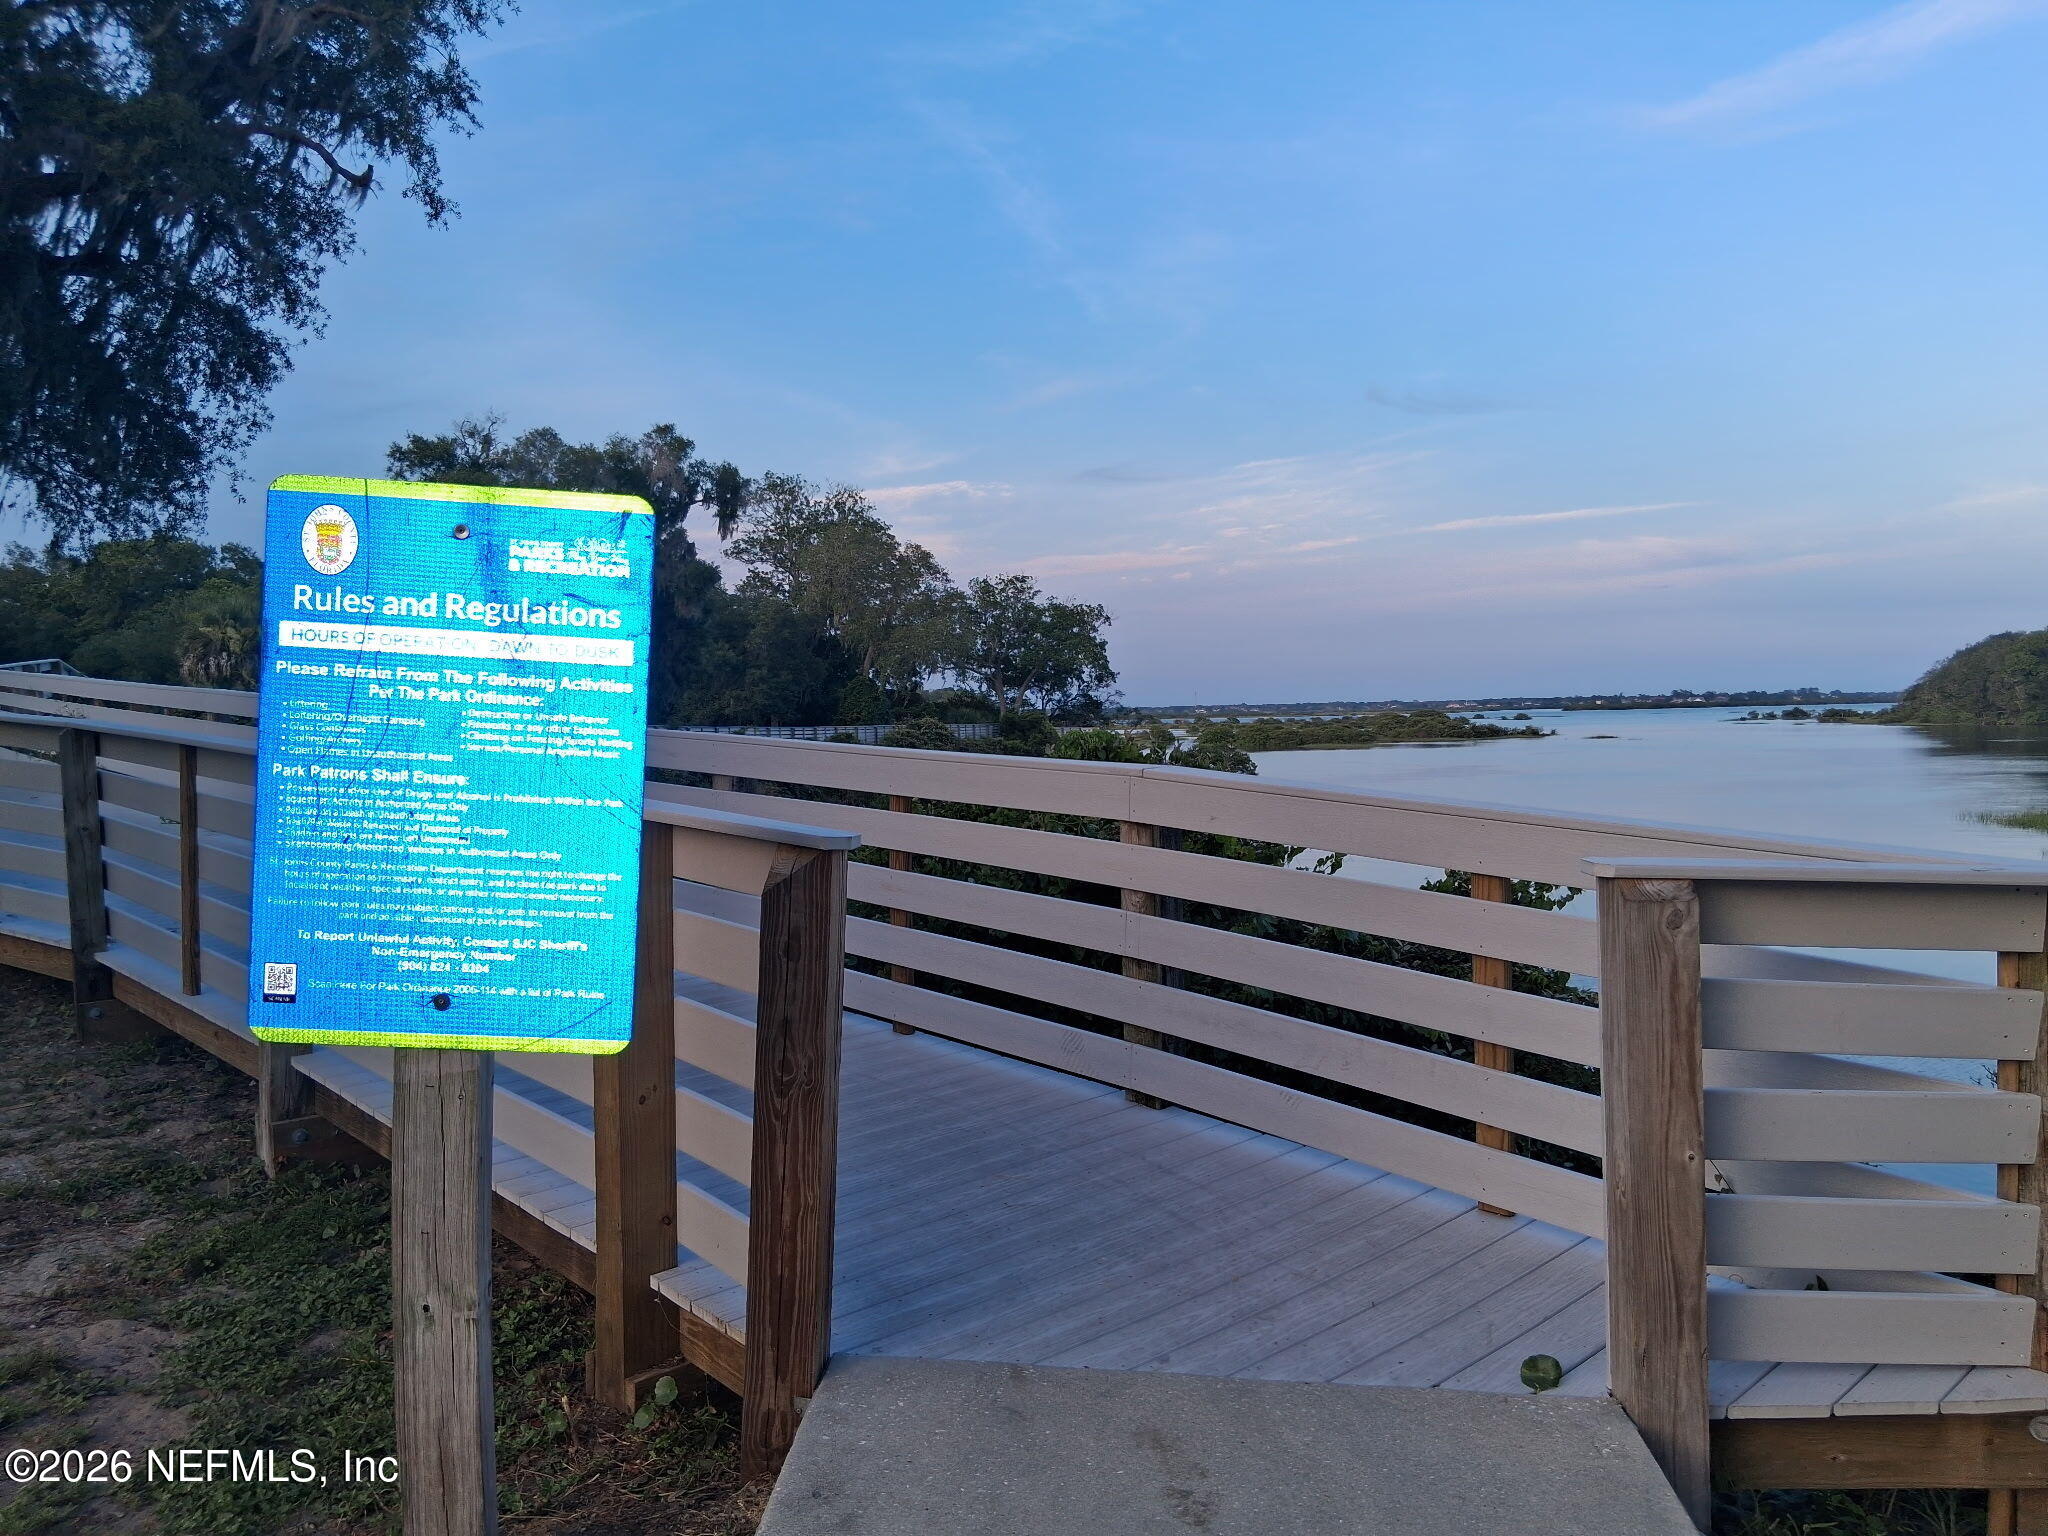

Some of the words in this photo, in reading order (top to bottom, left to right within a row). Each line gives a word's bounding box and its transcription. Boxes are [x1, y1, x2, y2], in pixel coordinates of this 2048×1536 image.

[294, 584, 375, 614] Rules
[383, 592, 438, 617] and
[445, 593, 622, 628] Regulations
[292, 628, 349, 644] HOURS
[354, 631, 375, 645] OF
[490, 639, 540, 654] DAWN
[550, 642, 568, 656] TO
[575, 645, 619, 659] DUSK
[276, 660, 329, 677] Please
[334, 663, 392, 679] Refrain
[396, 667, 438, 682] From
[443, 670, 474, 685] The
[477, 671, 556, 692] Following
[560, 677, 634, 693] Activities
[290, 700, 328, 710] Littering
[369, 684, 394, 700] Per
[399, 686, 425, 701] The
[428, 688, 461, 703] Park
[465, 690, 544, 706] Ordinance:
[288, 746, 314, 756] Open
[273, 763, 306, 777] Park
[310, 764, 368, 782] Patrons
[372, 768, 408, 783] Shall
[413, 770, 470, 786] Ensure:
[298, 929, 311, 940] To
[314, 930, 354, 942] Report
[358, 932, 410, 944] Unlawful
[462, 936, 510, 948] Contact
[512, 938, 536, 950] SJC
[372, 946, 466, 962] Non-Emergency
[470, 950, 517, 962] Number
